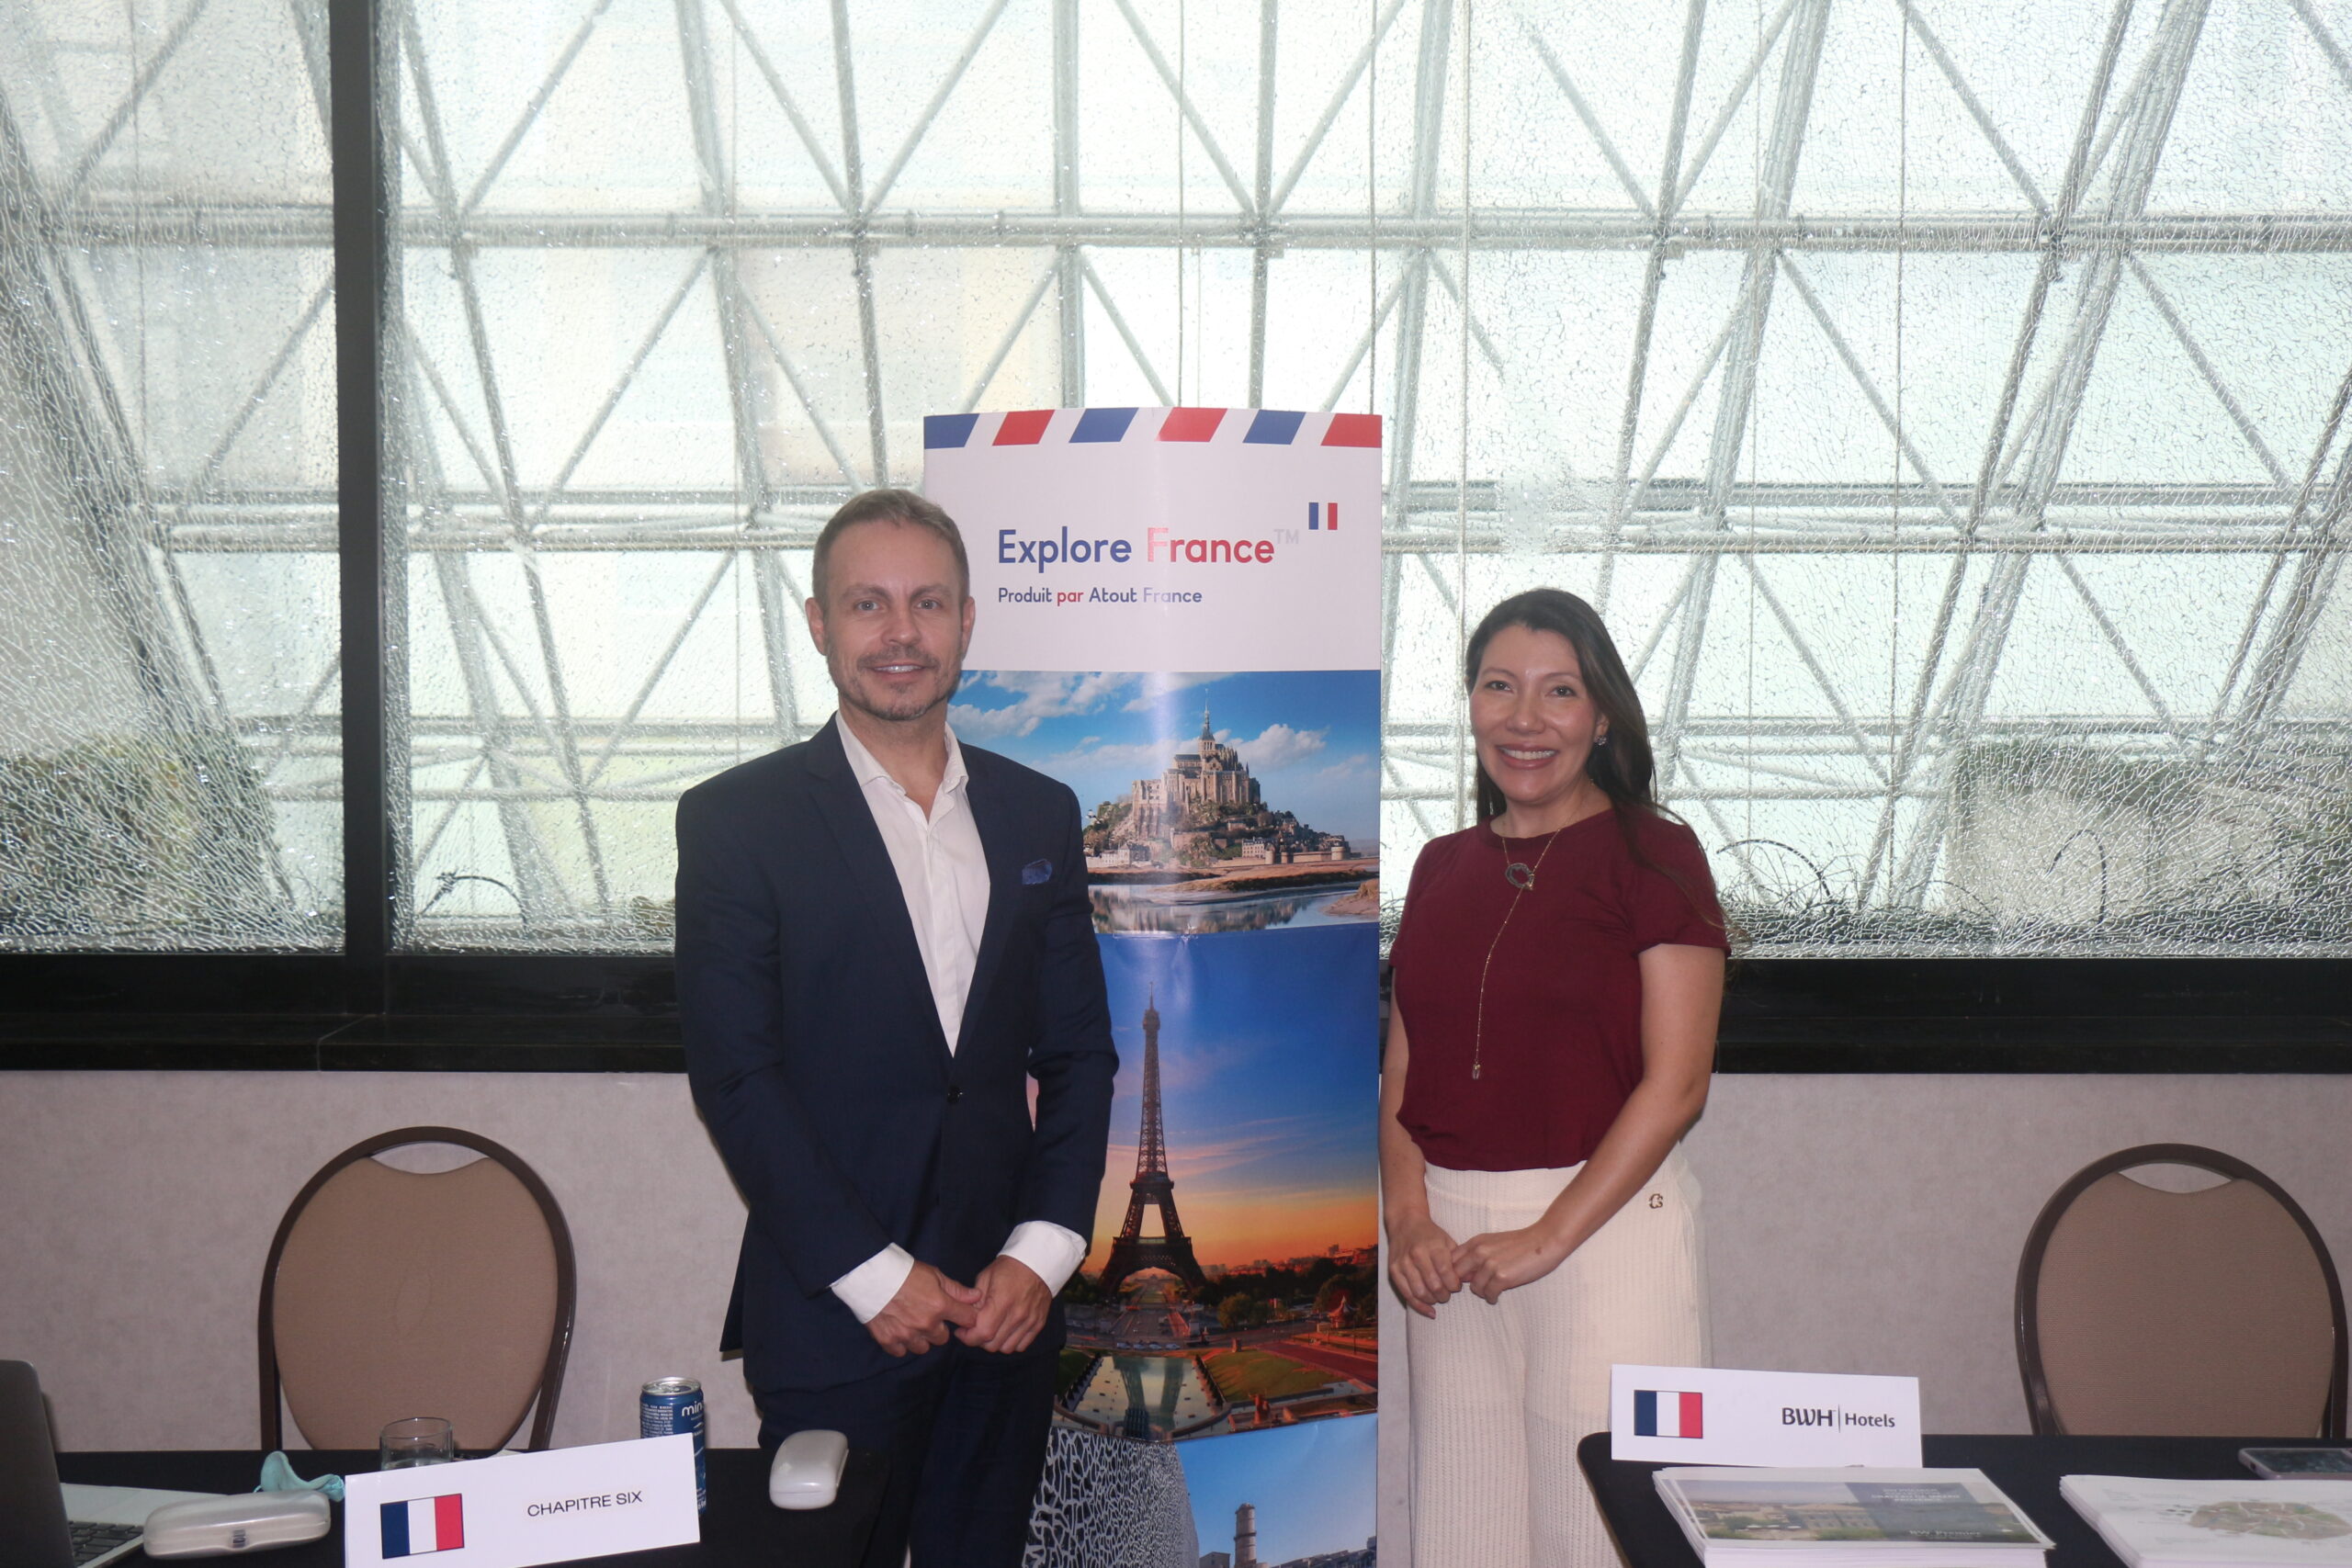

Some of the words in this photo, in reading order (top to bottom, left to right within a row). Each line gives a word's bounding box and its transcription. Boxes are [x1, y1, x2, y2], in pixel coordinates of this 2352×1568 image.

[999, 525, 1132, 573] Explore
[999, 587, 1052, 603] Produit
[1057, 592, 1084, 606] par
[1089, 587, 1137, 603] Atout
[1143, 587, 1203, 603] France
[682, 1400, 704, 1416] min
[1781, 1406, 1834, 1427] BWH
[1845, 1413, 1895, 1427] Hotels
[527, 1495, 613, 1517] CHAPITRE
[616, 1490, 643, 1506] SIX
